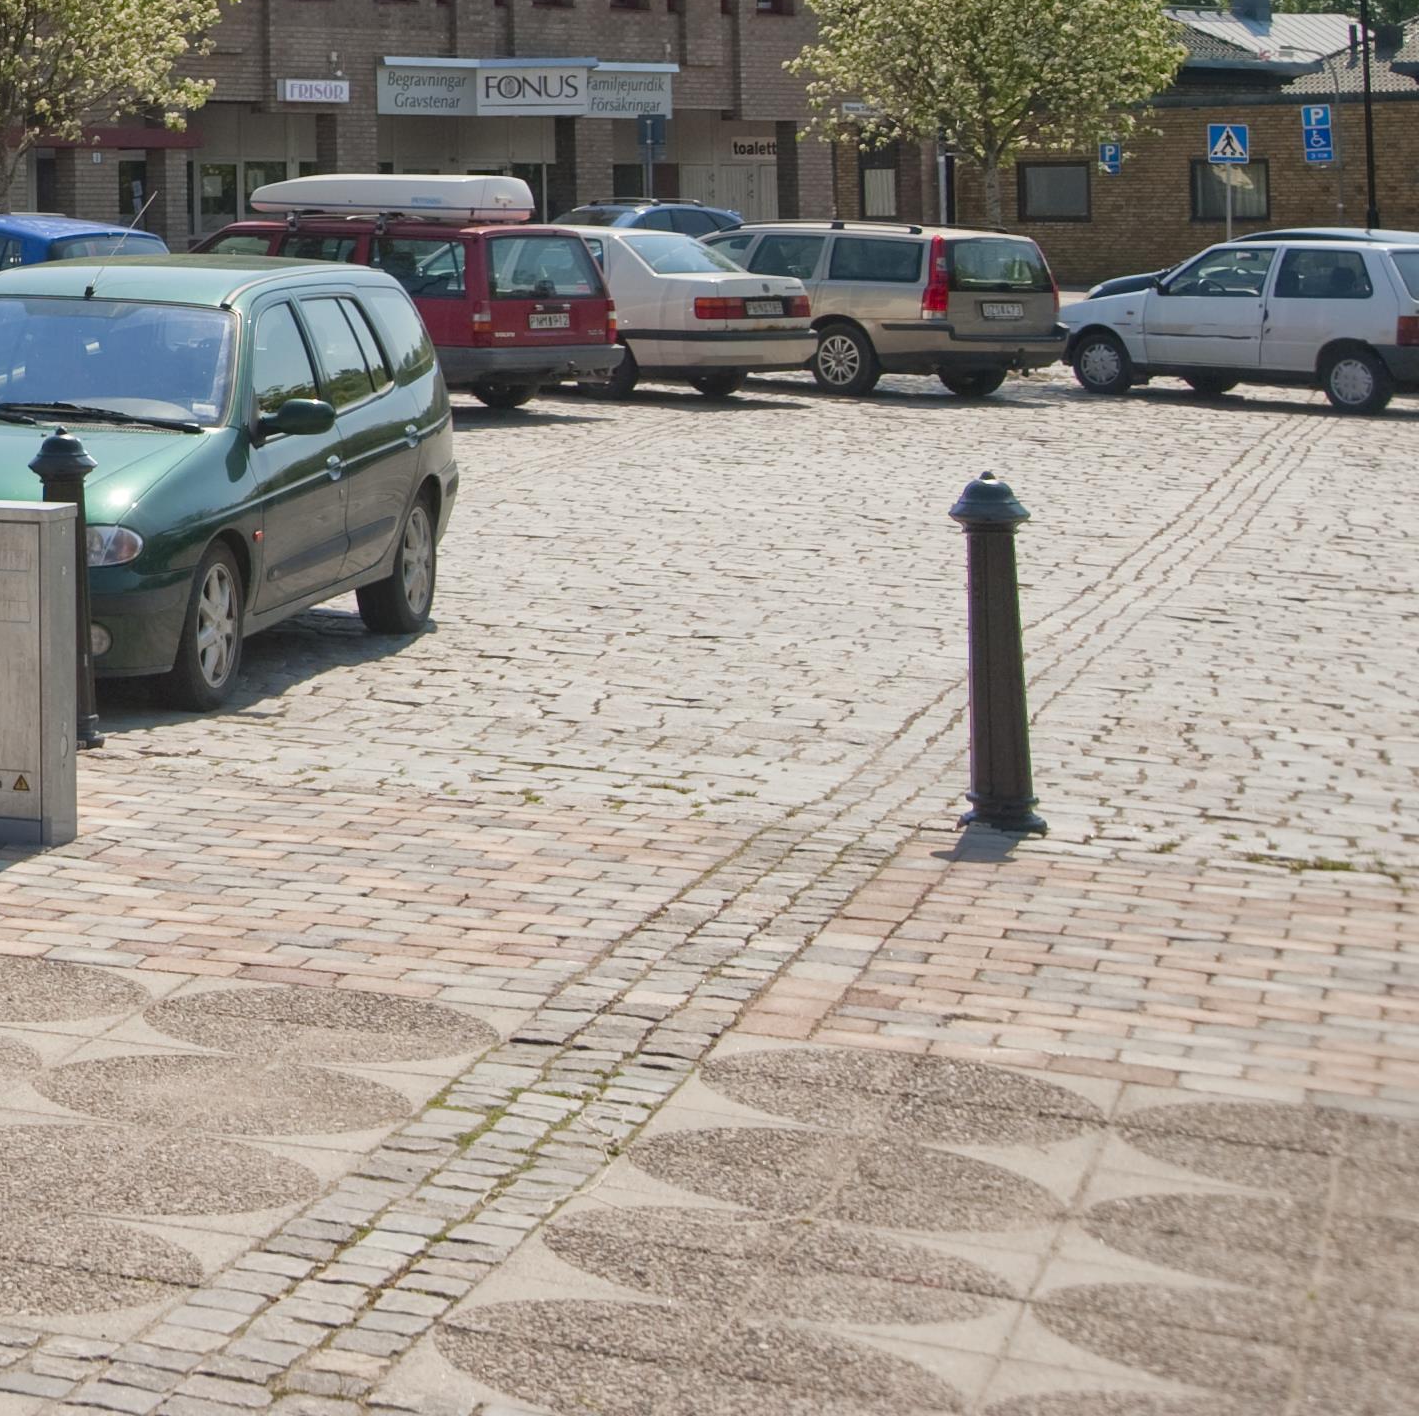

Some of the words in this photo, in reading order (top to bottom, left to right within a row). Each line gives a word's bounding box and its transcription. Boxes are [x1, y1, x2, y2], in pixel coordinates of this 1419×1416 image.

[290, 81, 344, 100] FRISÖR
[387, 71, 467, 92] Begravningar
[484, 74, 579, 99] FONUS
[587, 75, 665, 96] Familjejuridik
[394, 92, 460, 108] Gravstenar
[591, 96, 662, 115] Försäkringar
[1310, 107, 1324, 126] P
[733, 140, 778, 155] toalett
[1105, 144, 1115, 162] P
